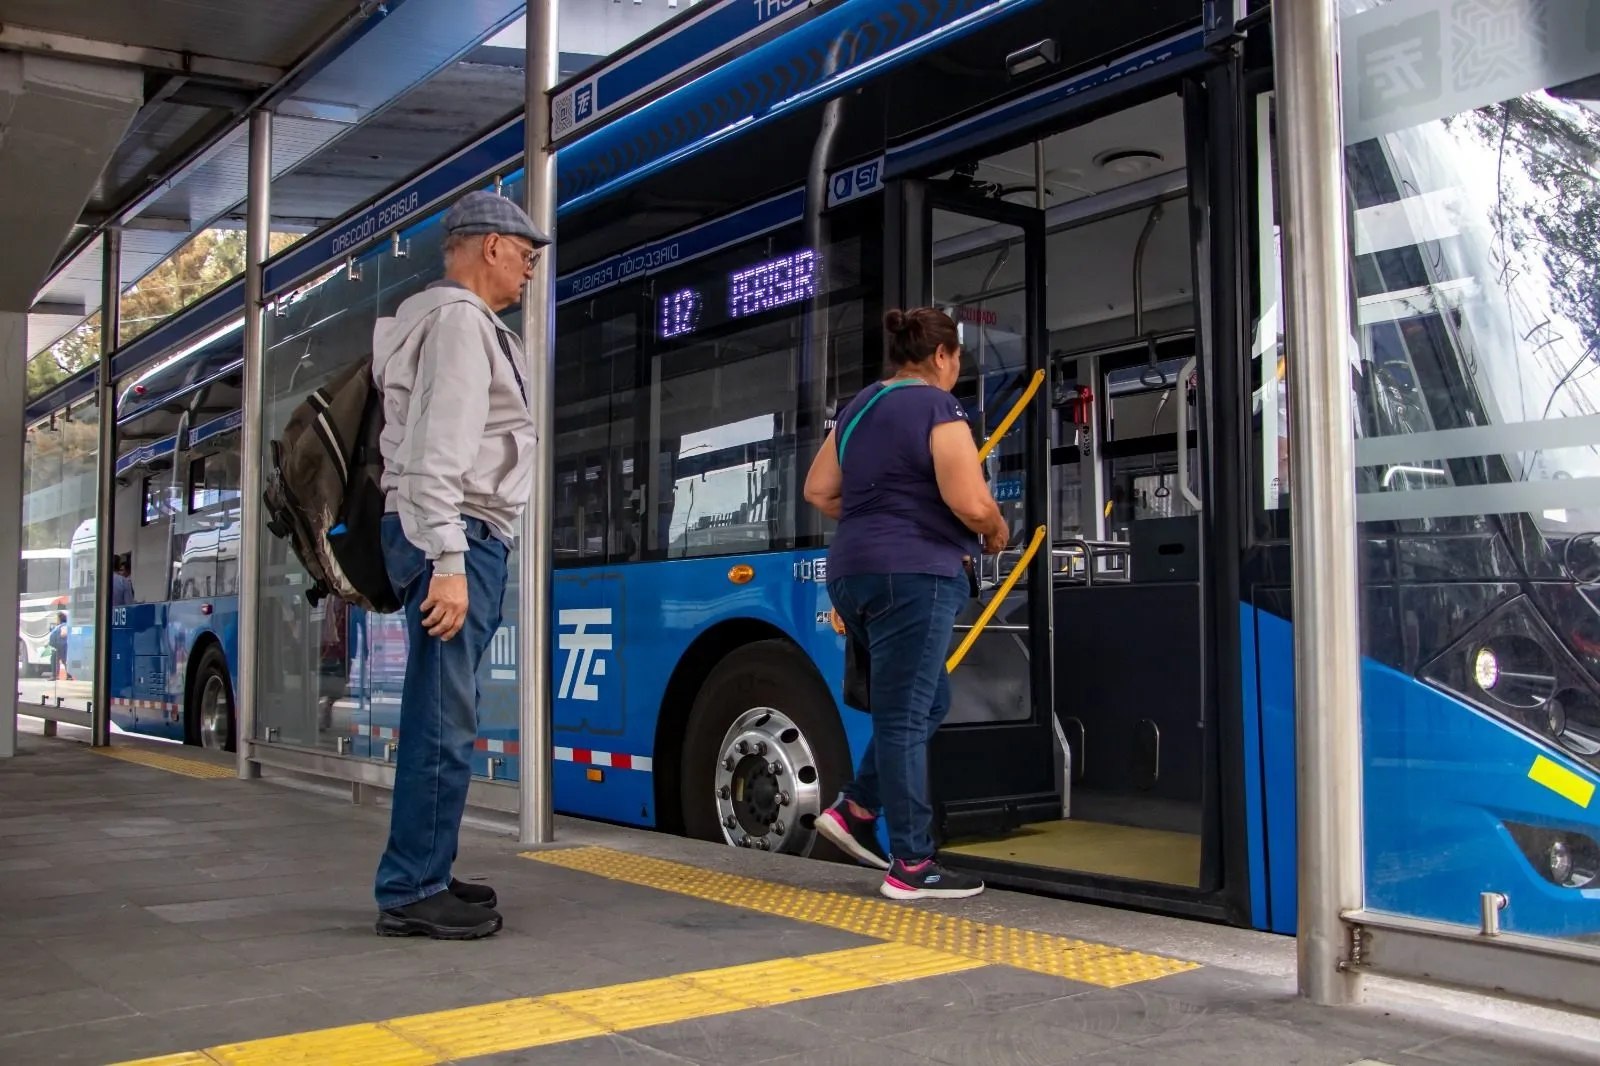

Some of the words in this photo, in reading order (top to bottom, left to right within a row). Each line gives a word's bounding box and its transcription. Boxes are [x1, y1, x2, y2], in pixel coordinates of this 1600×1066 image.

[332, 215, 375, 255] DIRECCIÓN
[378, 191, 419, 228] PERISUR
[732, 250, 814, 317] PERISUR
